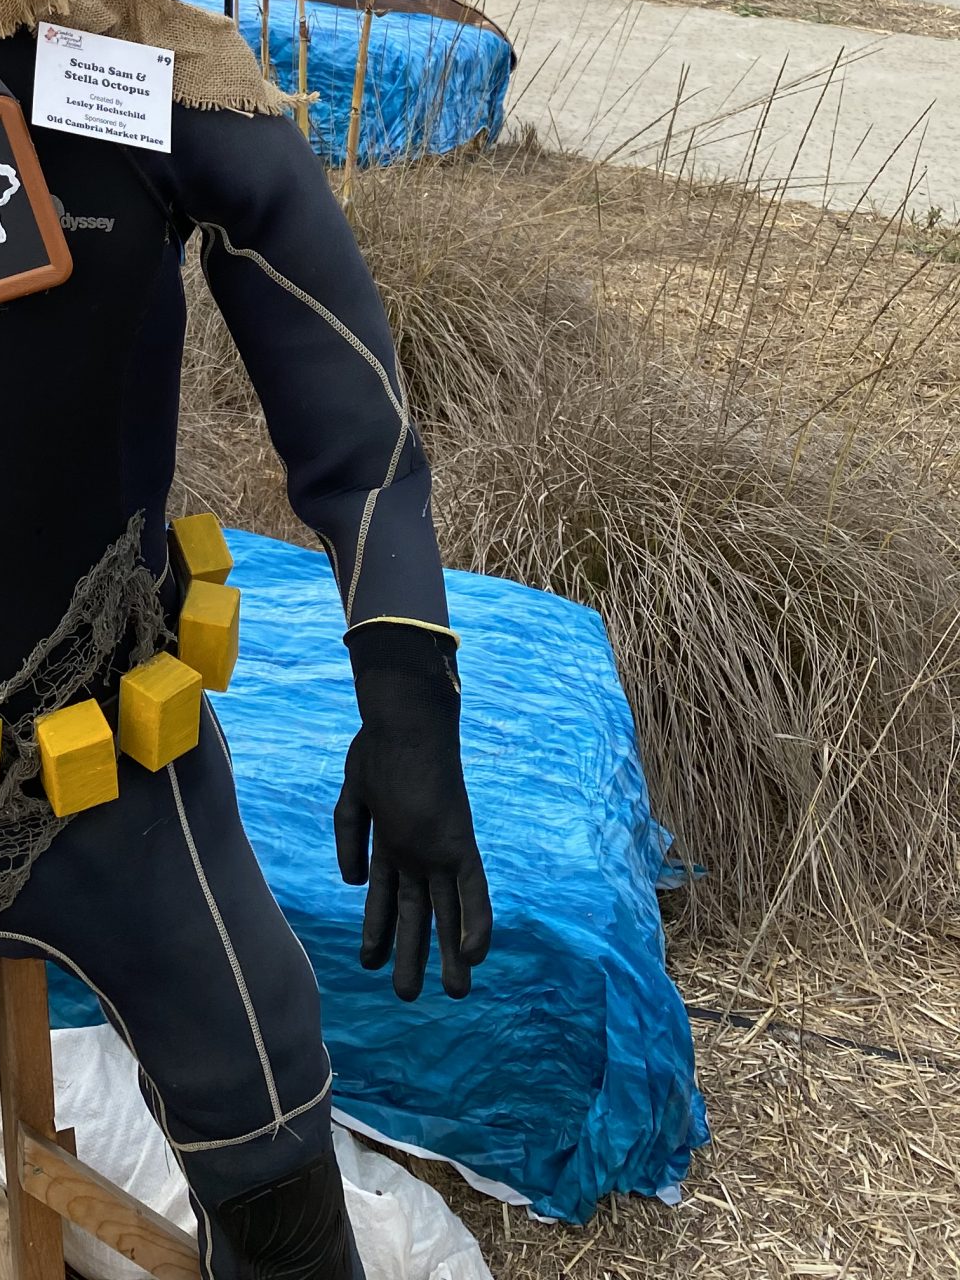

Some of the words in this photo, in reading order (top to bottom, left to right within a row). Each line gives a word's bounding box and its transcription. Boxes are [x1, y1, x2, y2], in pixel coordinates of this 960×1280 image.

[69, 57, 105, 74] Scuba
[108, 66, 133, 80] Sam
[136, 72, 146, 82] &
[157, 54, 172, 66] #9
[64, 70, 99, 86] Stella
[101, 78, 150, 97] Octopus
[66, 96, 94, 110] Lesley
[96, 103, 146, 120] Hochschild
[89, 93, 114, 104] Created
[115, 97, 123, 107] By
[46, 114, 63, 124] Old
[65, 118, 104, 133] Cambria
[105, 126, 138, 140] Market
[140, 134, 164, 146] Place
[84, 114, 117, 127] Sponsored
[118, 121, 127, 129] By
[58, 212, 115, 232] dyssey
